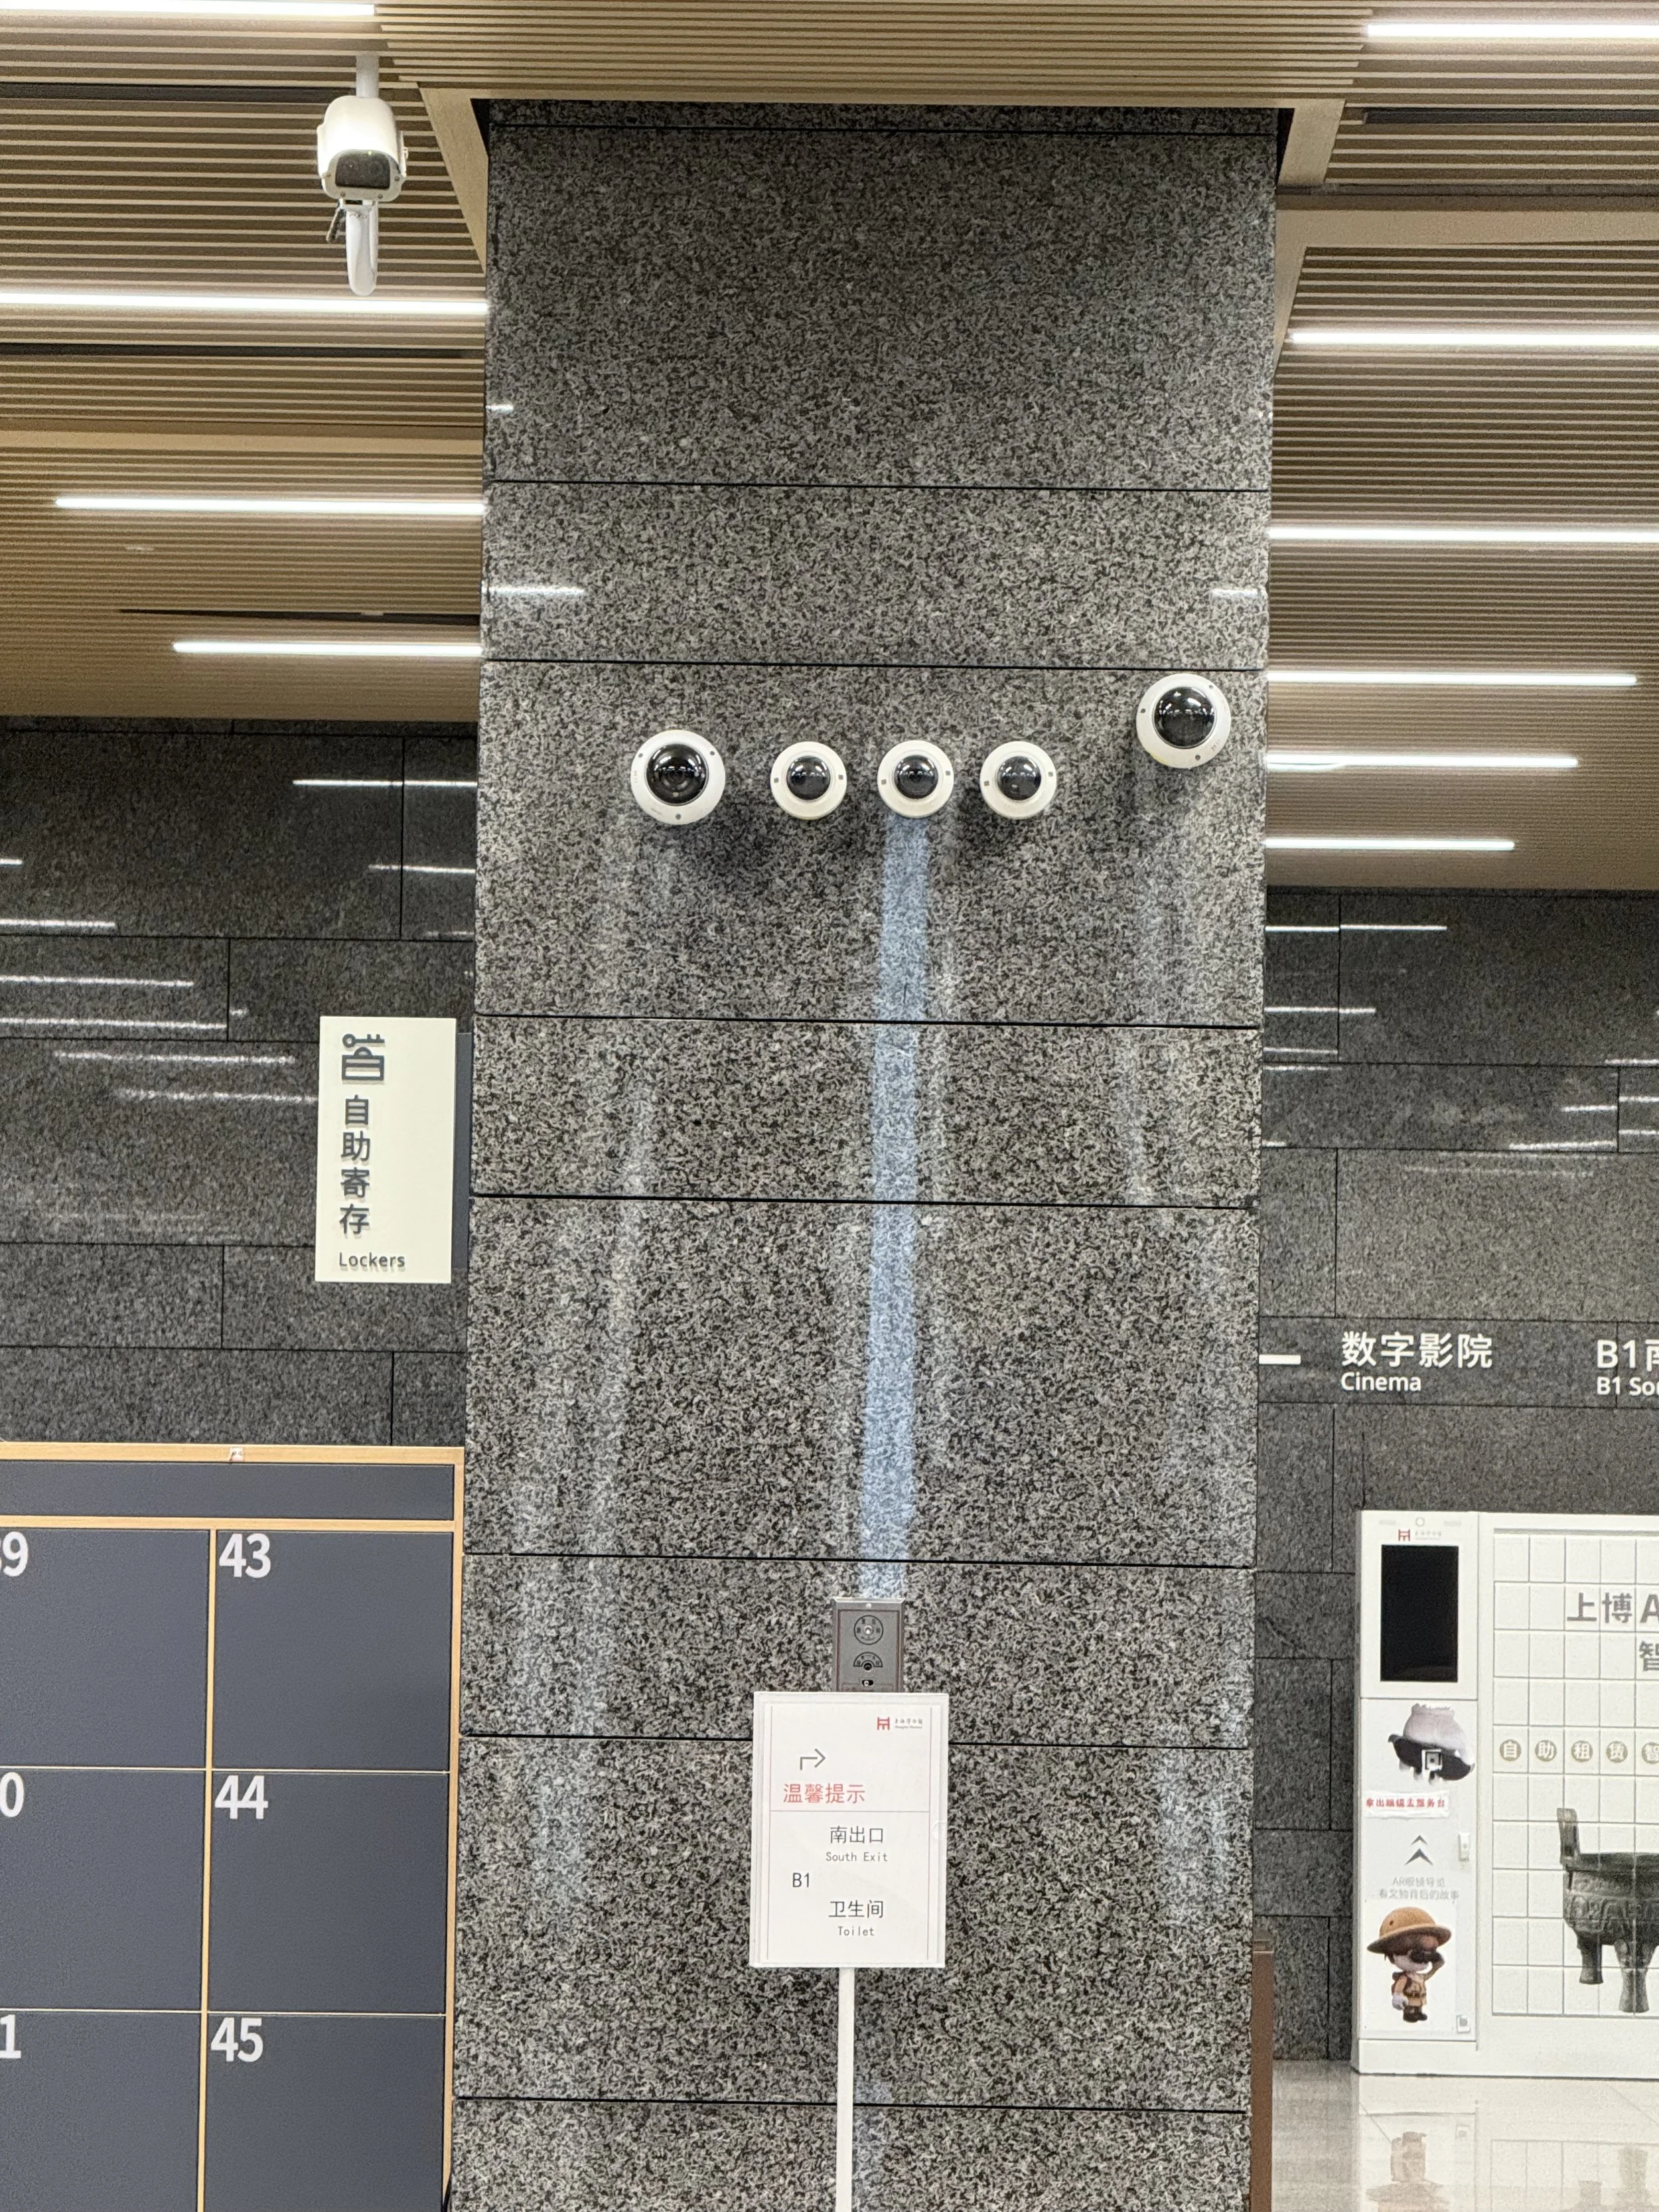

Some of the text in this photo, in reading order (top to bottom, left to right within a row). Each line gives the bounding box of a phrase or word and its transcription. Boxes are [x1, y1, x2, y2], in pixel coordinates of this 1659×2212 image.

[339, 1094, 370, 1234] 自助寄存
[339, 1252, 405, 1267] Lockers
[1341, 1331, 1492, 1368] 数字影院
[1341, 1372, 1421, 1391] Cinema
[1597, 1376, 1659, 1396] B1 So
[0, 1531, 28, 1577] 9
[219, 1533, 271, 1578] 43
[214, 1775, 268, 1819] 44
[783, 1783, 865, 1804] 温馨提示
[830, 1826, 884, 1844] 南出口
[826, 1852, 888, 1862] South Exit
[792, 1872, 810, 1888] B1
[829, 1900, 884, 1919] 卫生间
[837, 1927, 875, 1937] Toilet
[211, 2018, 263, 2062] 45
